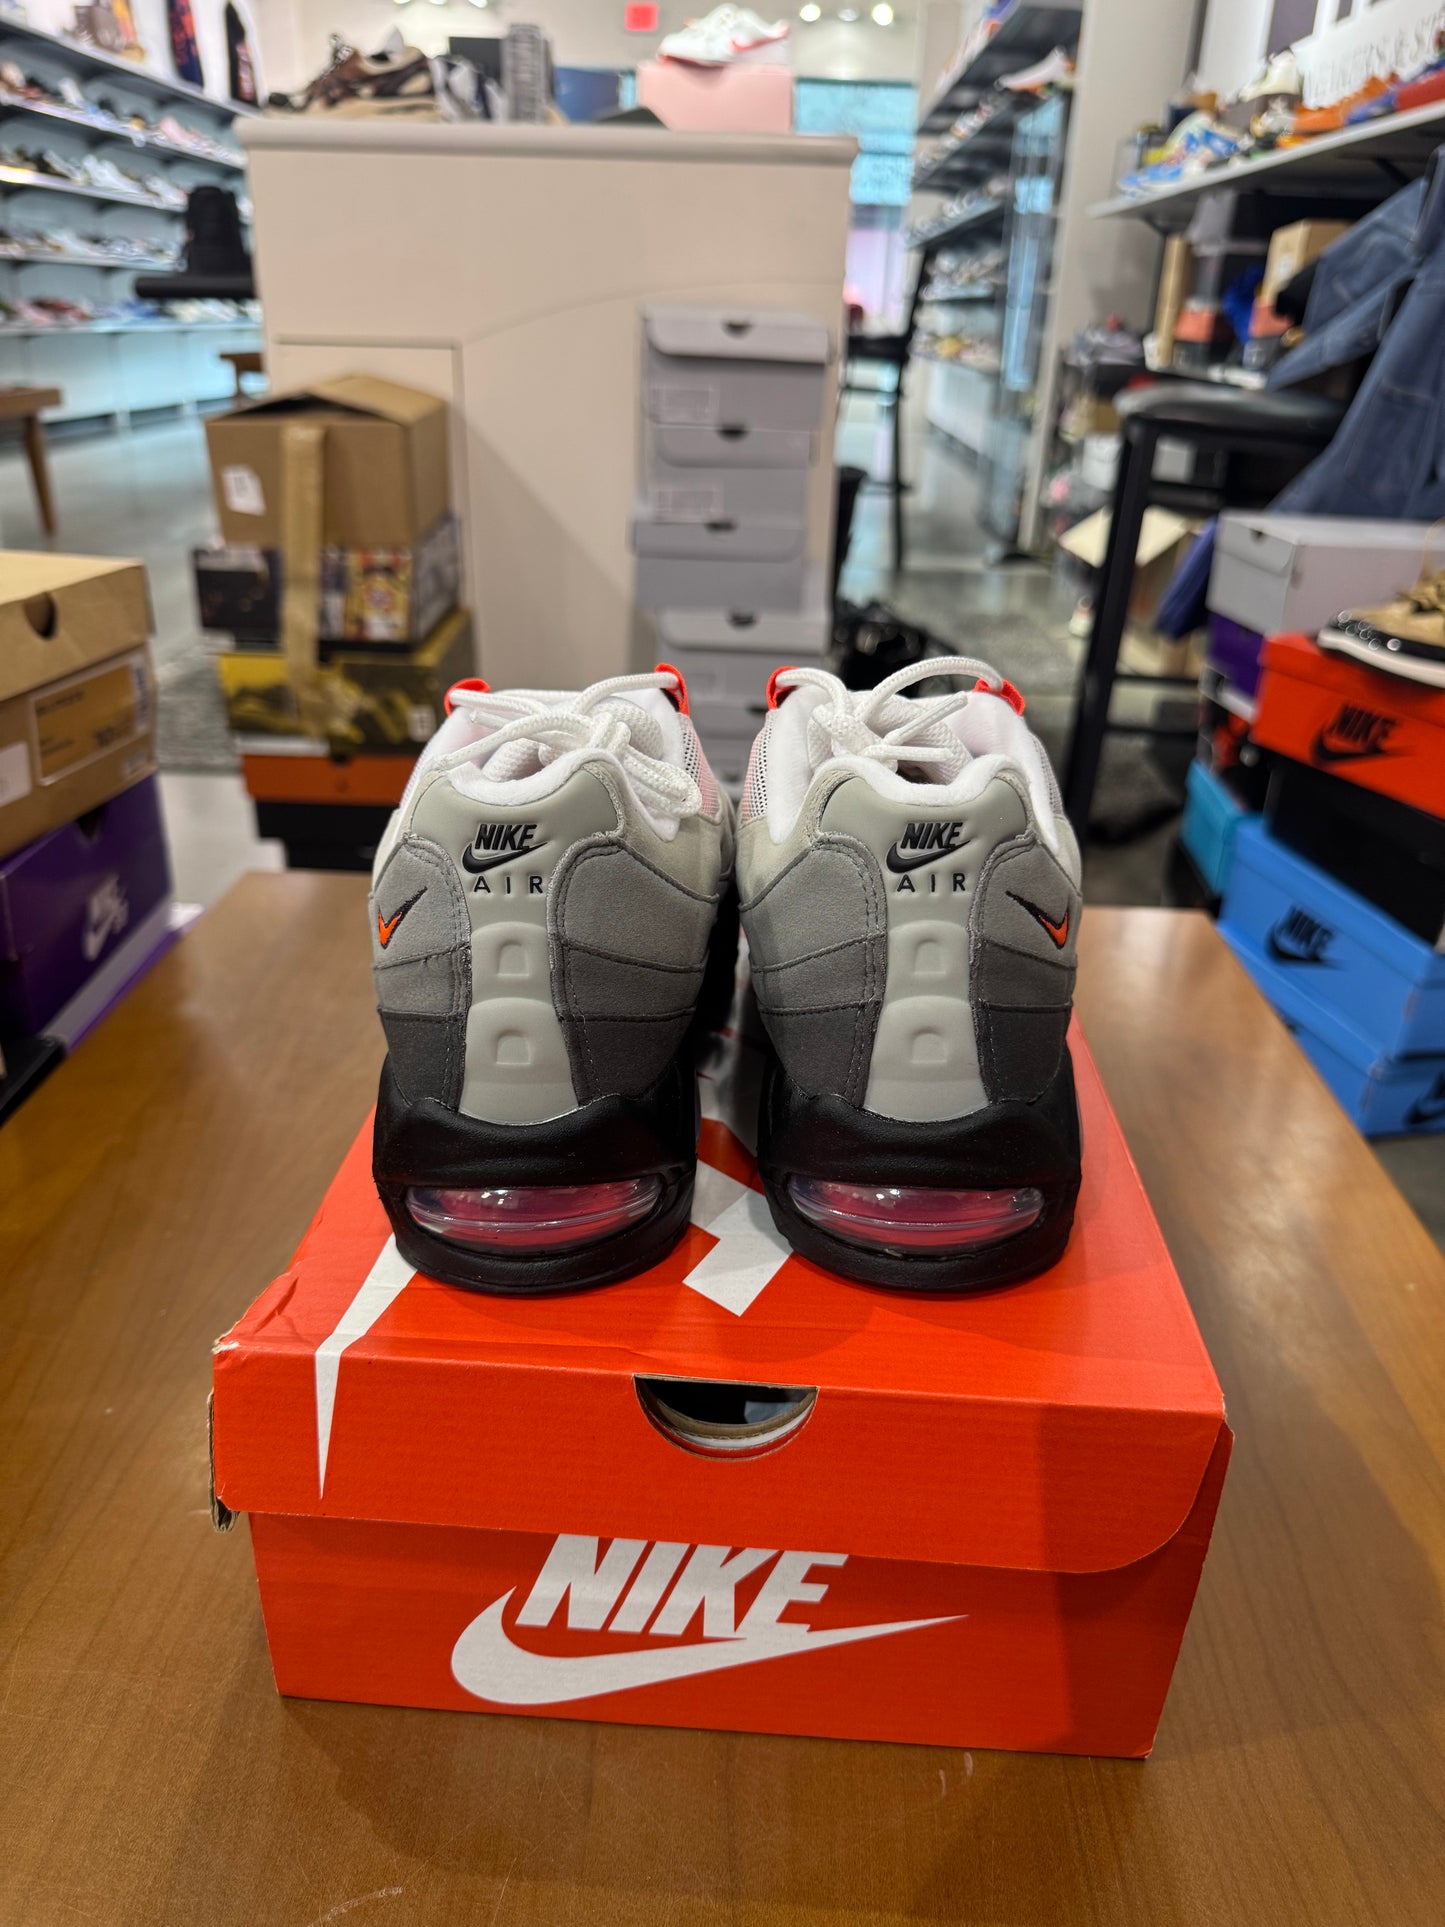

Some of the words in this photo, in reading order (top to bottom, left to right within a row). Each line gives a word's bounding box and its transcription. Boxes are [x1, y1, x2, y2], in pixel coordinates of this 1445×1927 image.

[474, 823, 537, 851] NIKE
[901, 822, 963, 850] NIKE
[473, 875, 543, 894] AIR
[896, 872, 966, 893] AIR
[514, 1533, 850, 1639] NIKE
